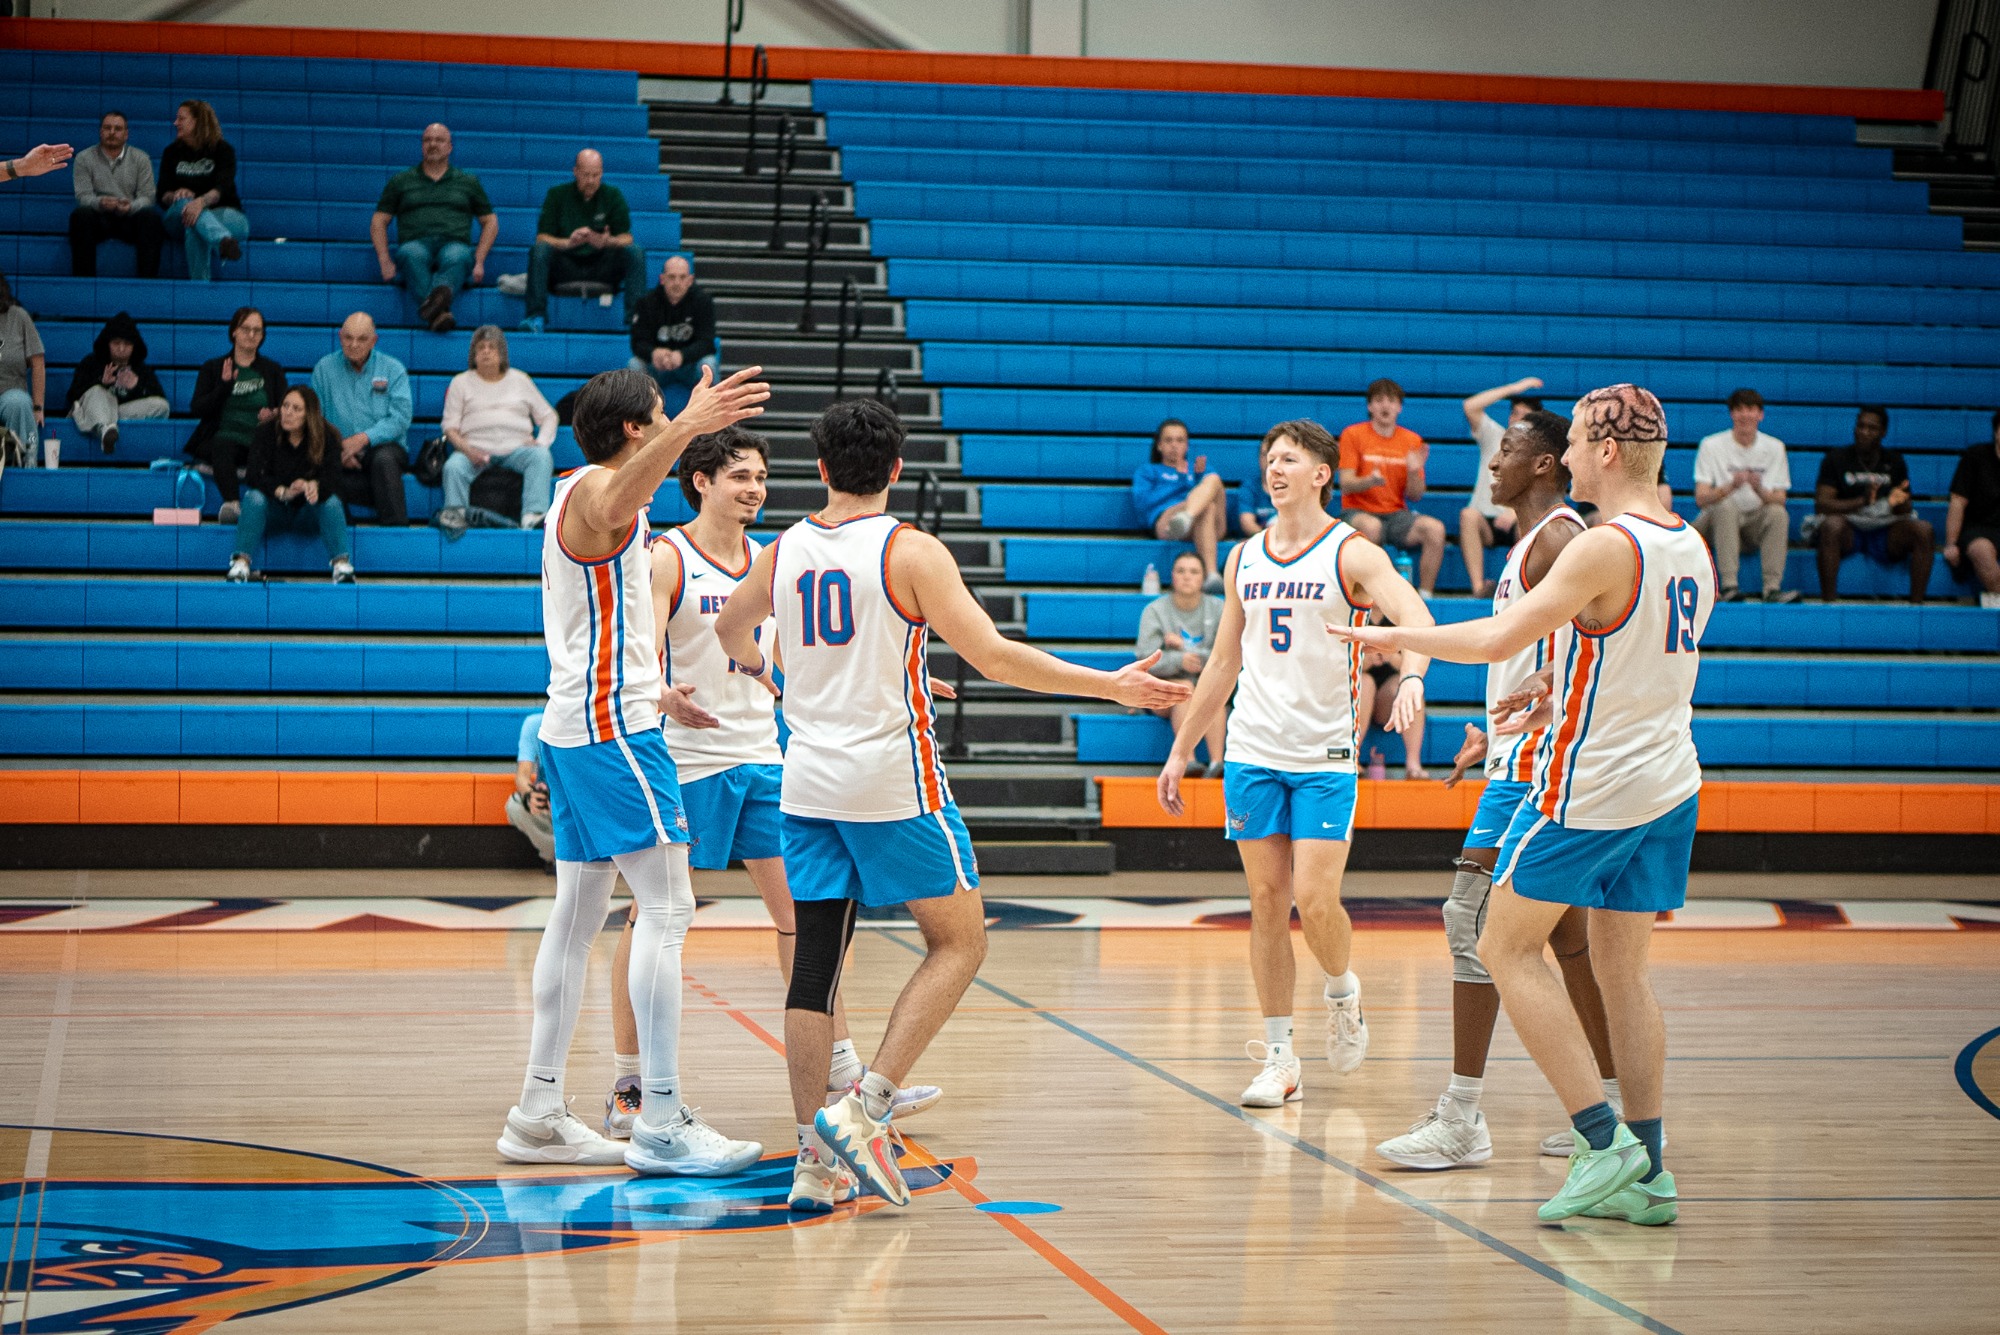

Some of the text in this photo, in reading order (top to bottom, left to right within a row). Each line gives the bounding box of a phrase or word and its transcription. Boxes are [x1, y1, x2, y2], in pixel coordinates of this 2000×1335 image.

[797, 569, 856, 647] 10
[1243, 582, 1326, 602] NEW PALTZ
[1665, 576, 1699, 654] 19
[1269, 608, 1293, 653] 5
